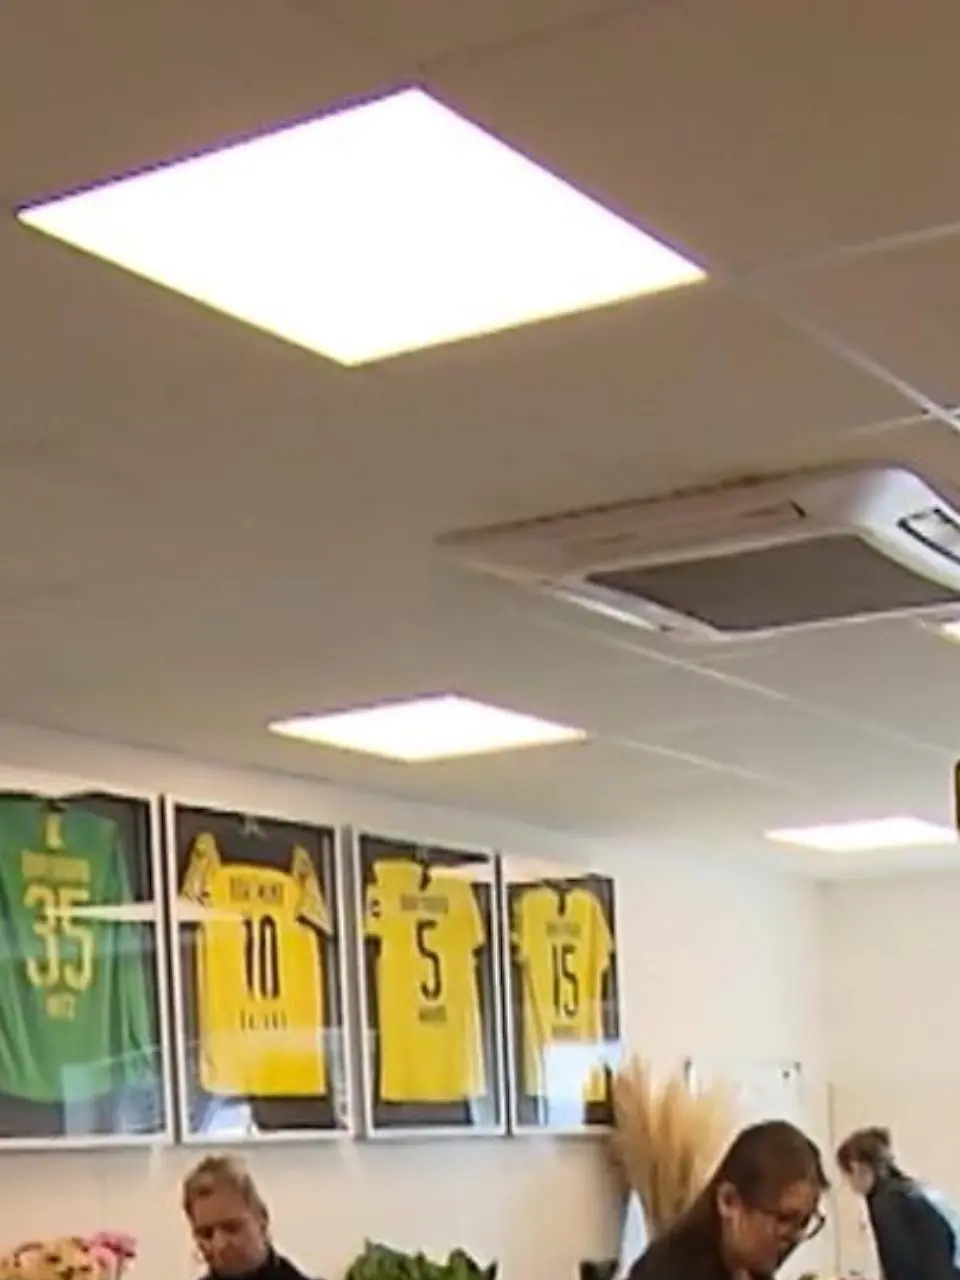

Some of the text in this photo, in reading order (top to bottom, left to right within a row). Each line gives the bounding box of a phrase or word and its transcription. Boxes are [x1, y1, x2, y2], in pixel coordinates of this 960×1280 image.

[24, 884, 94, 990] 35
[243, 913, 281, 999] 10
[416, 919, 442, 1000] 5
[551, 943, 579, 1016] 15
